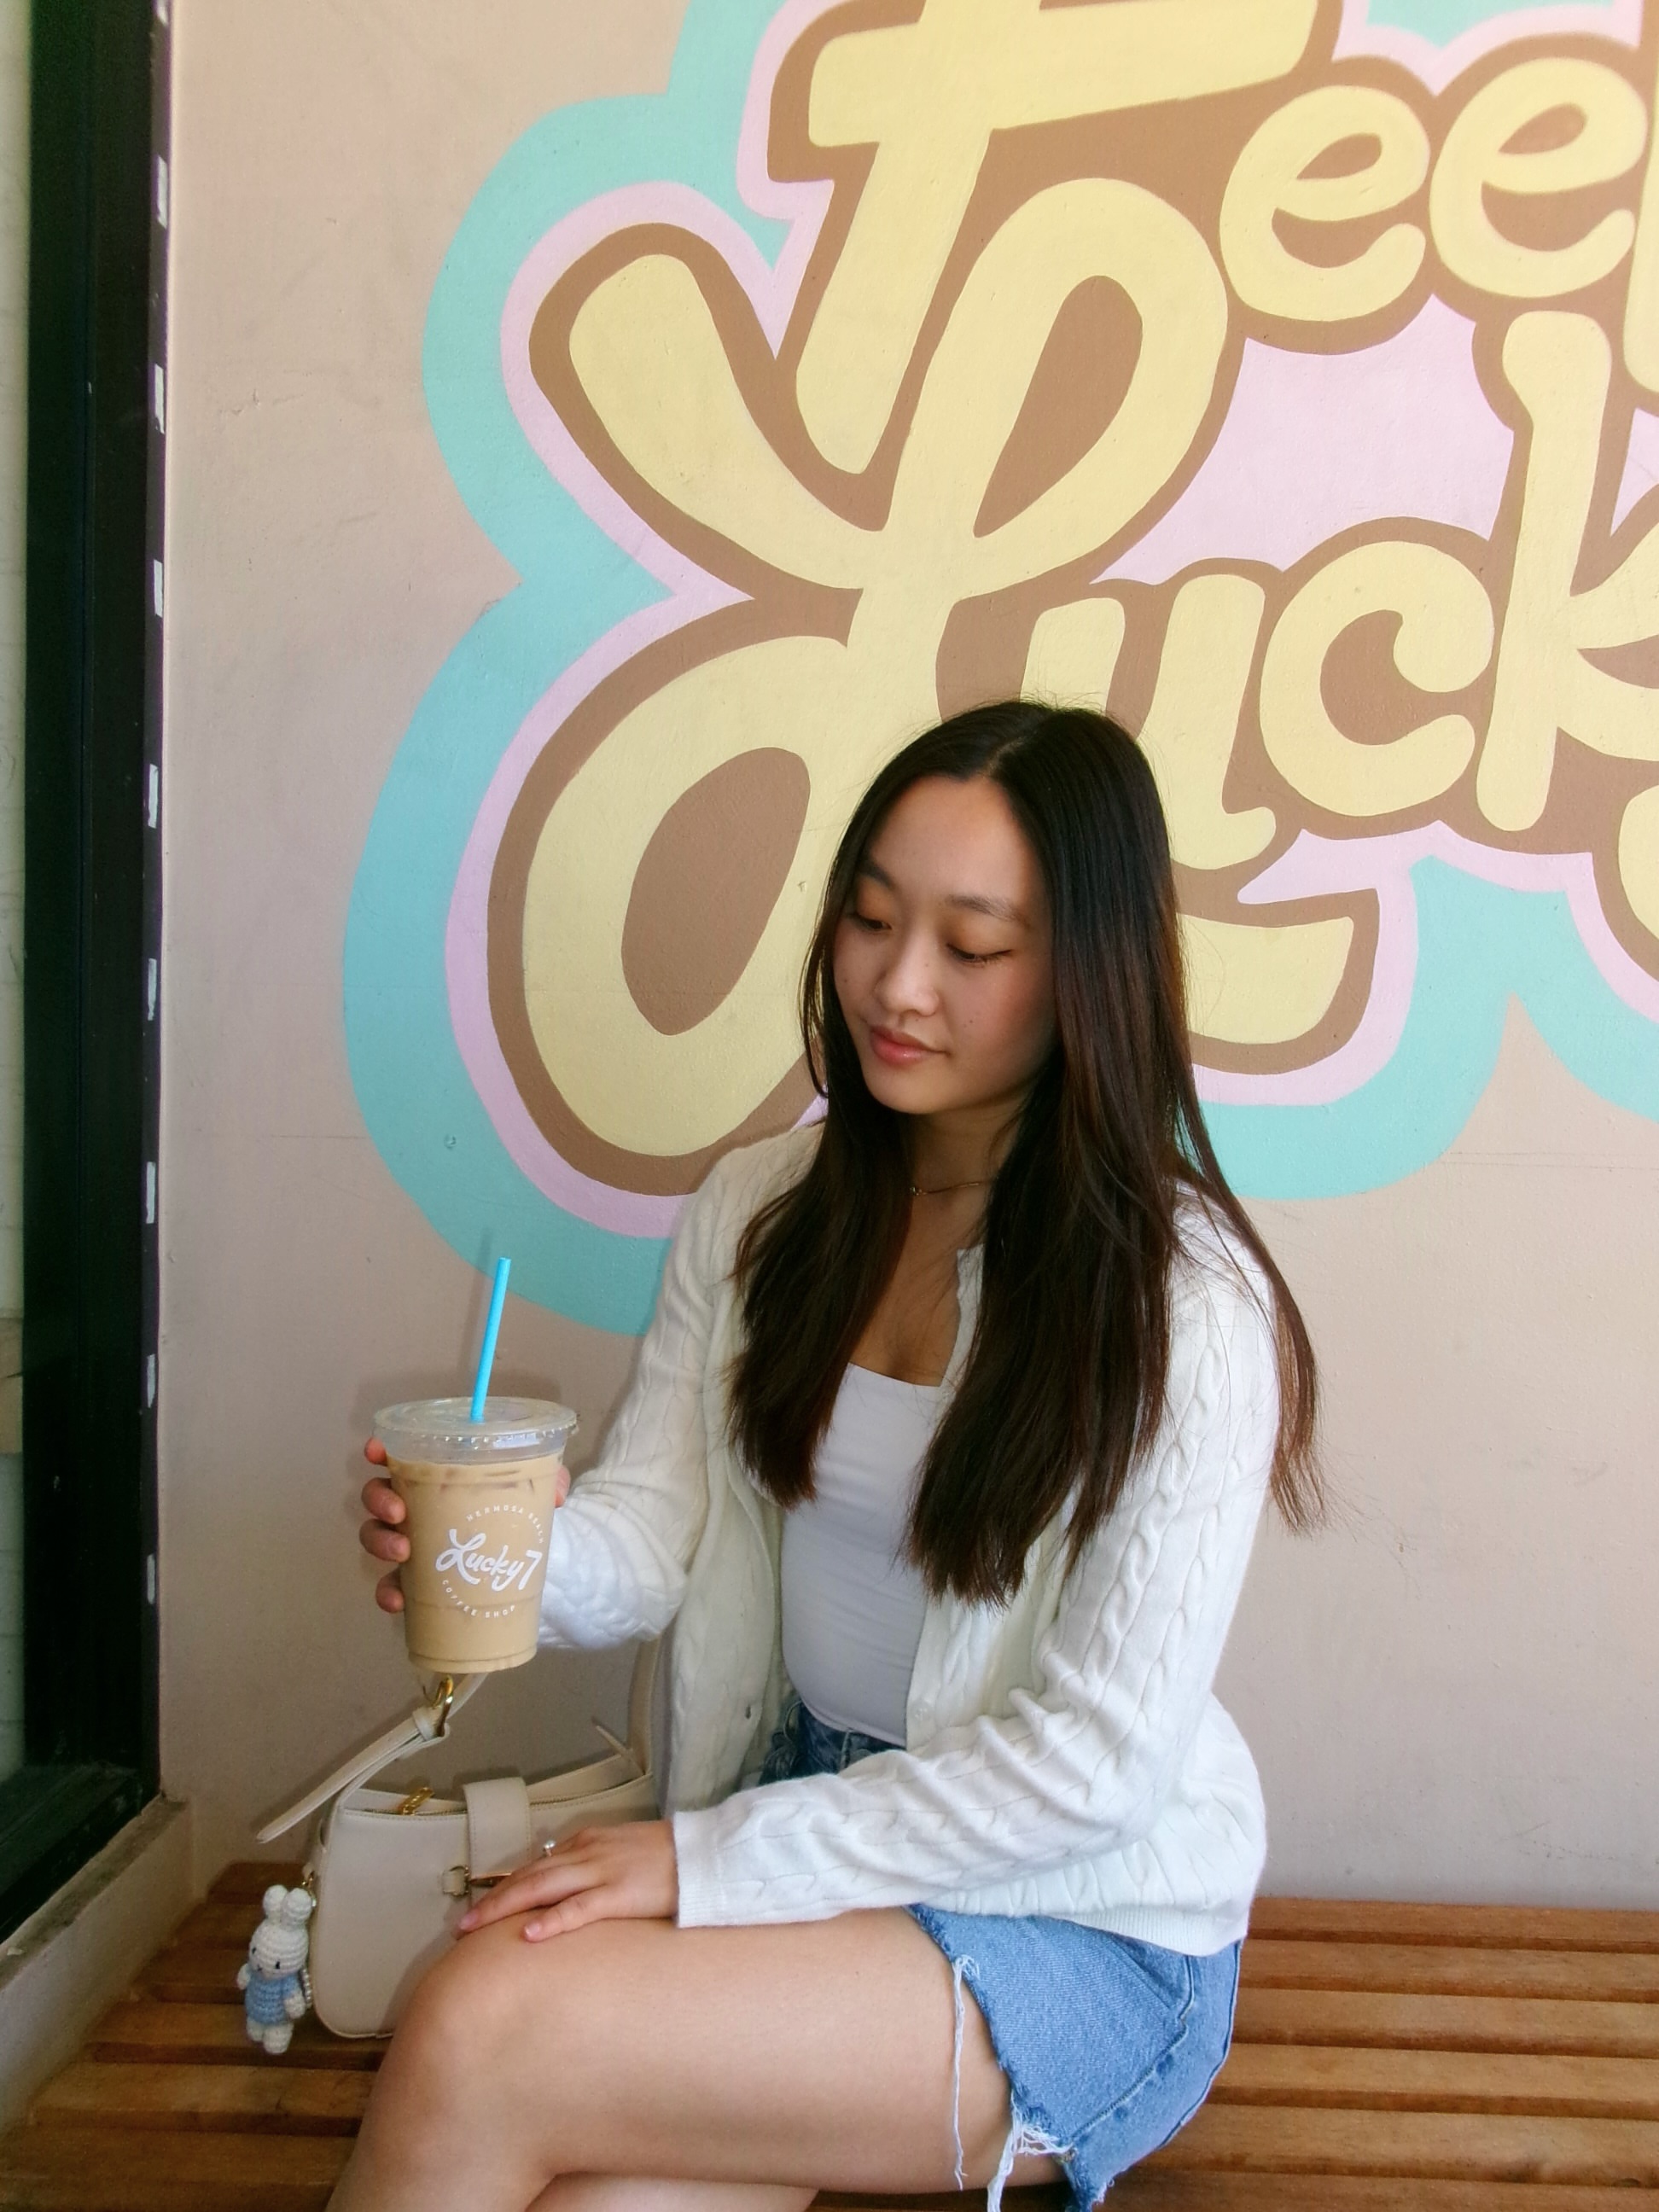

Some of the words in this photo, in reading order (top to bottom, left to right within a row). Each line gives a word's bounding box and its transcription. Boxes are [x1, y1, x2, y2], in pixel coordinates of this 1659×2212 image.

[522, 178, 1659, 1157] Luck
[466, 1505, 524, 1522] HERMOSA
[442, 1580, 478, 1616] COFFEE
[485, 1604, 515, 1618] SHOP
